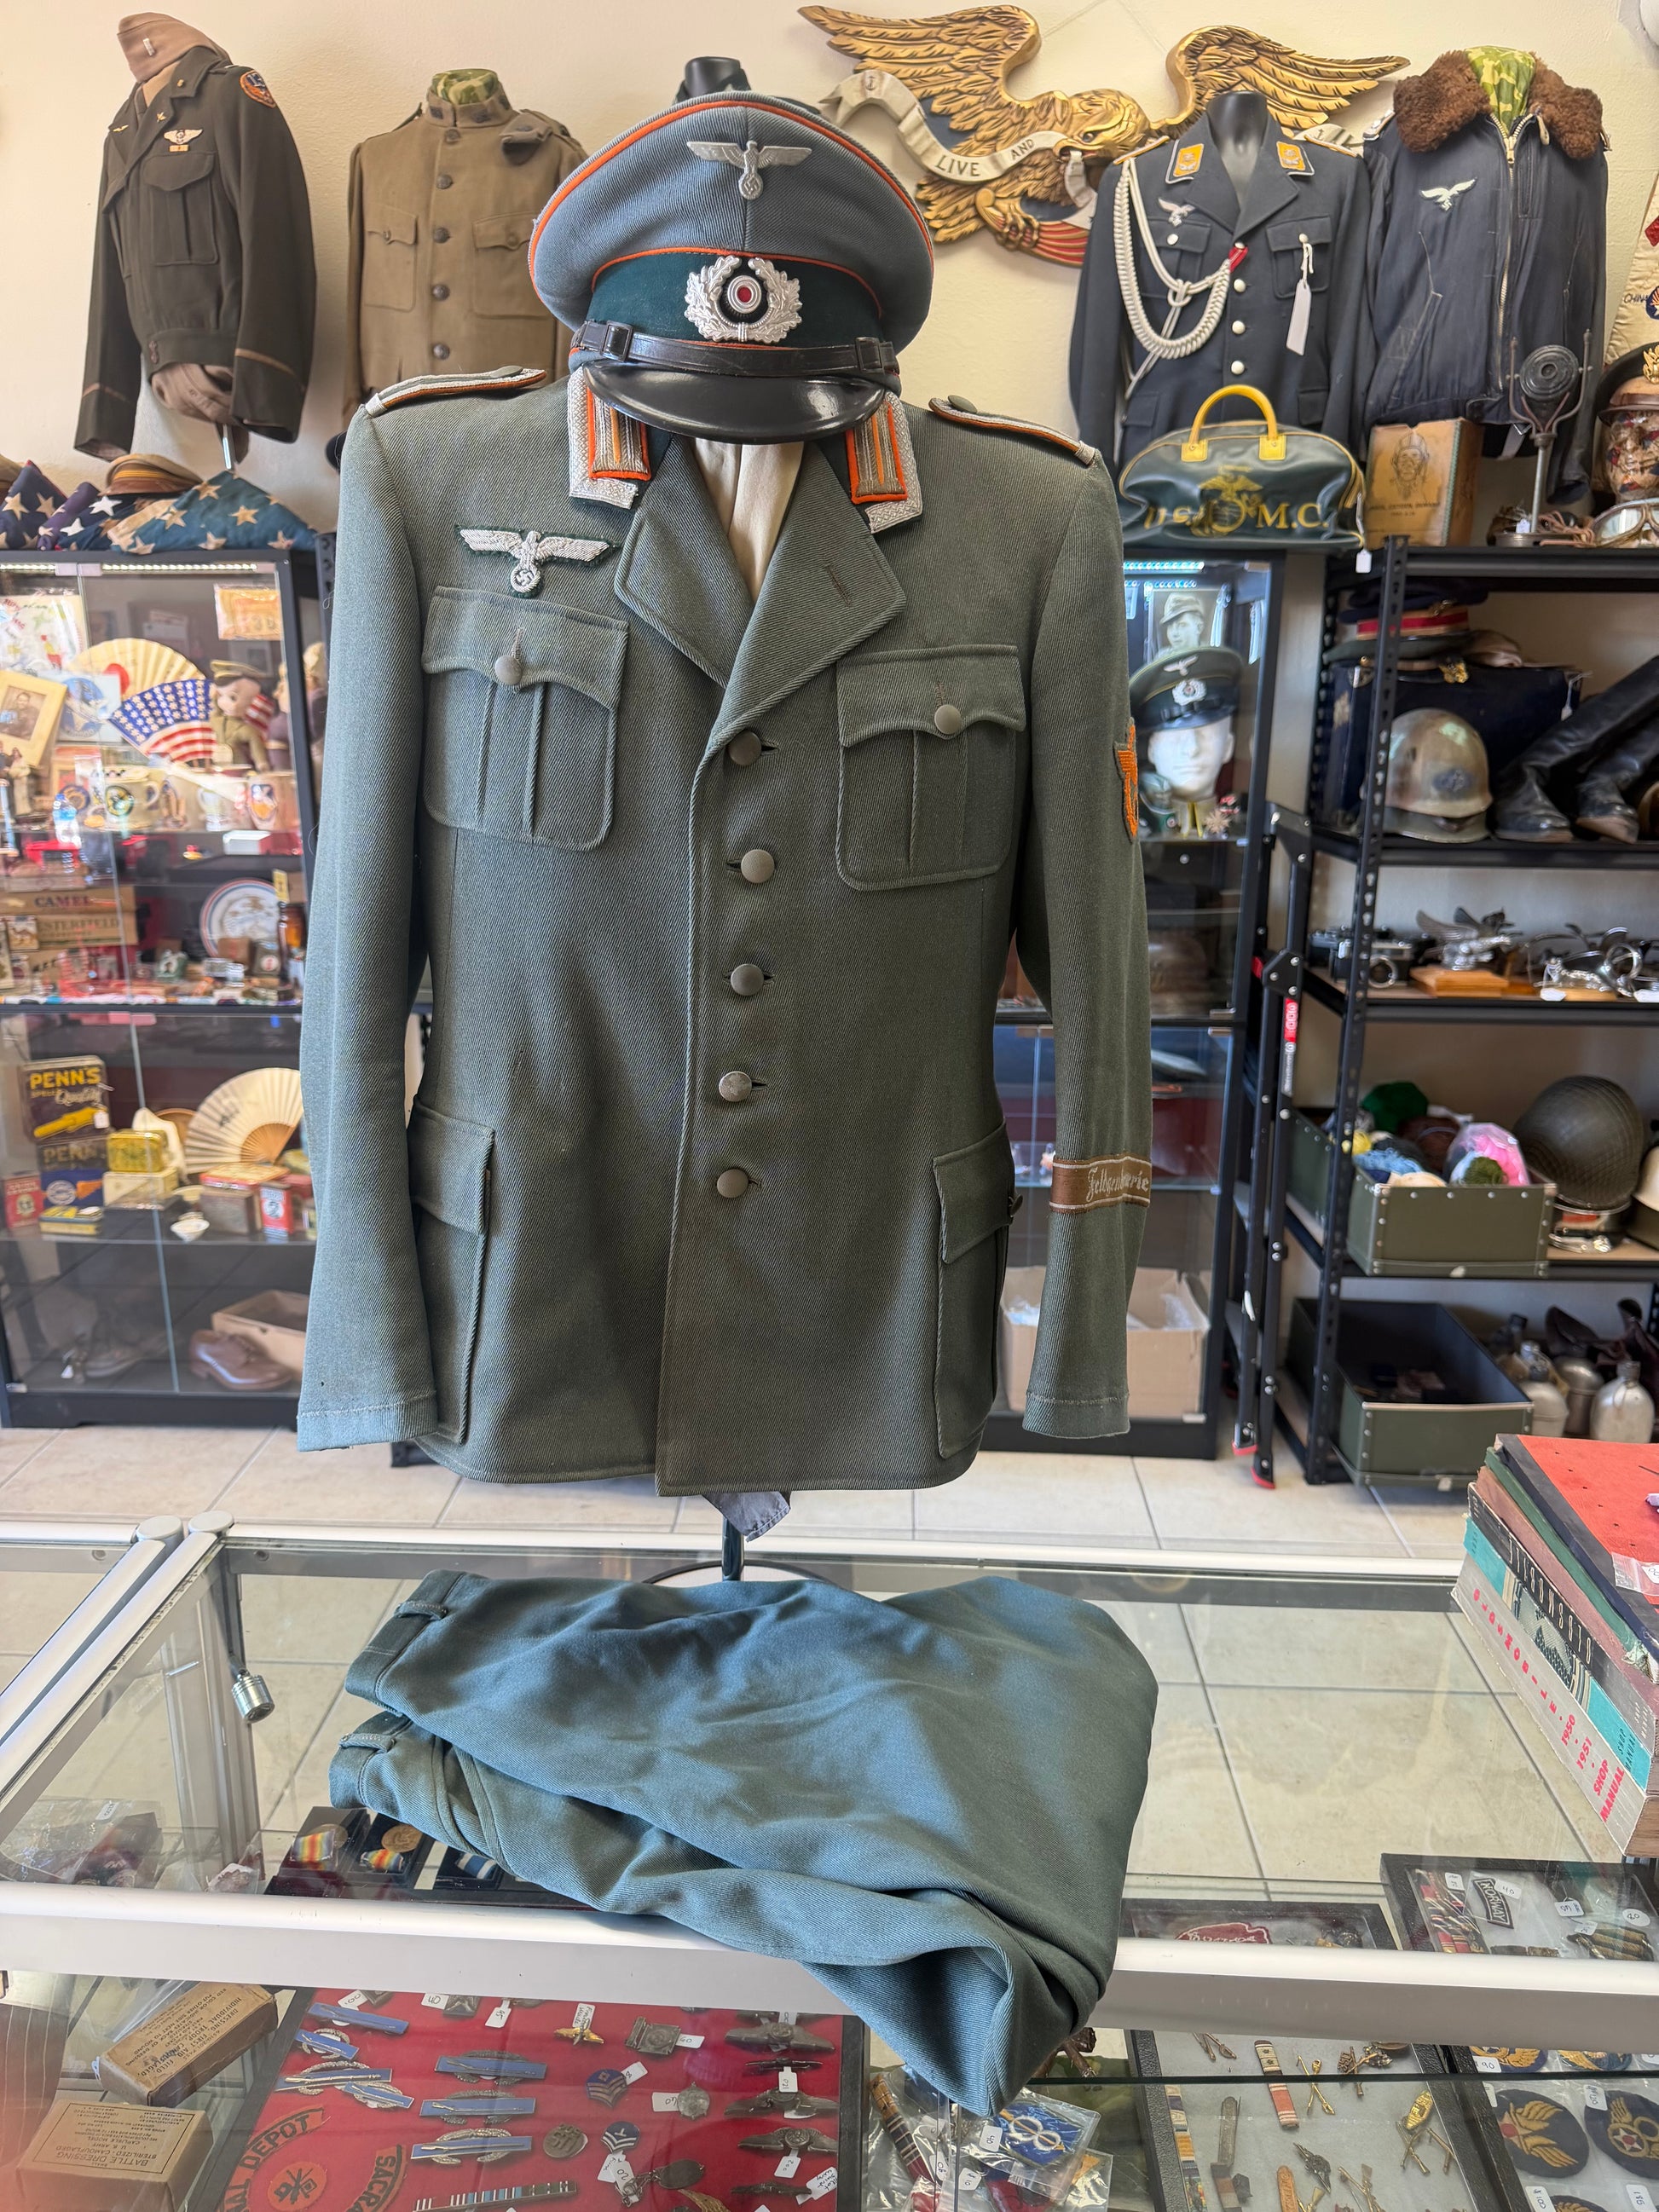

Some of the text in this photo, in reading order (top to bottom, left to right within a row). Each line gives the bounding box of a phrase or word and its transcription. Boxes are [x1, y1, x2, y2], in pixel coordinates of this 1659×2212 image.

[935, 138, 1035, 178] LIVE AND
[1473, 1588, 1625, 1822] OLDSMOBILE 1950 1951 SHOP MANUAL
[1480, 1880, 1506, 1923] NORWAY
[207, 1996, 241, 2024] INDIVIDUAL
[55, 2145, 157, 2159] STERILIZED CAMOUFLAGED
[55, 2151, 148, 2167] BATTLE DRESSING
[240, 2115, 310, 2170] DEPOT
